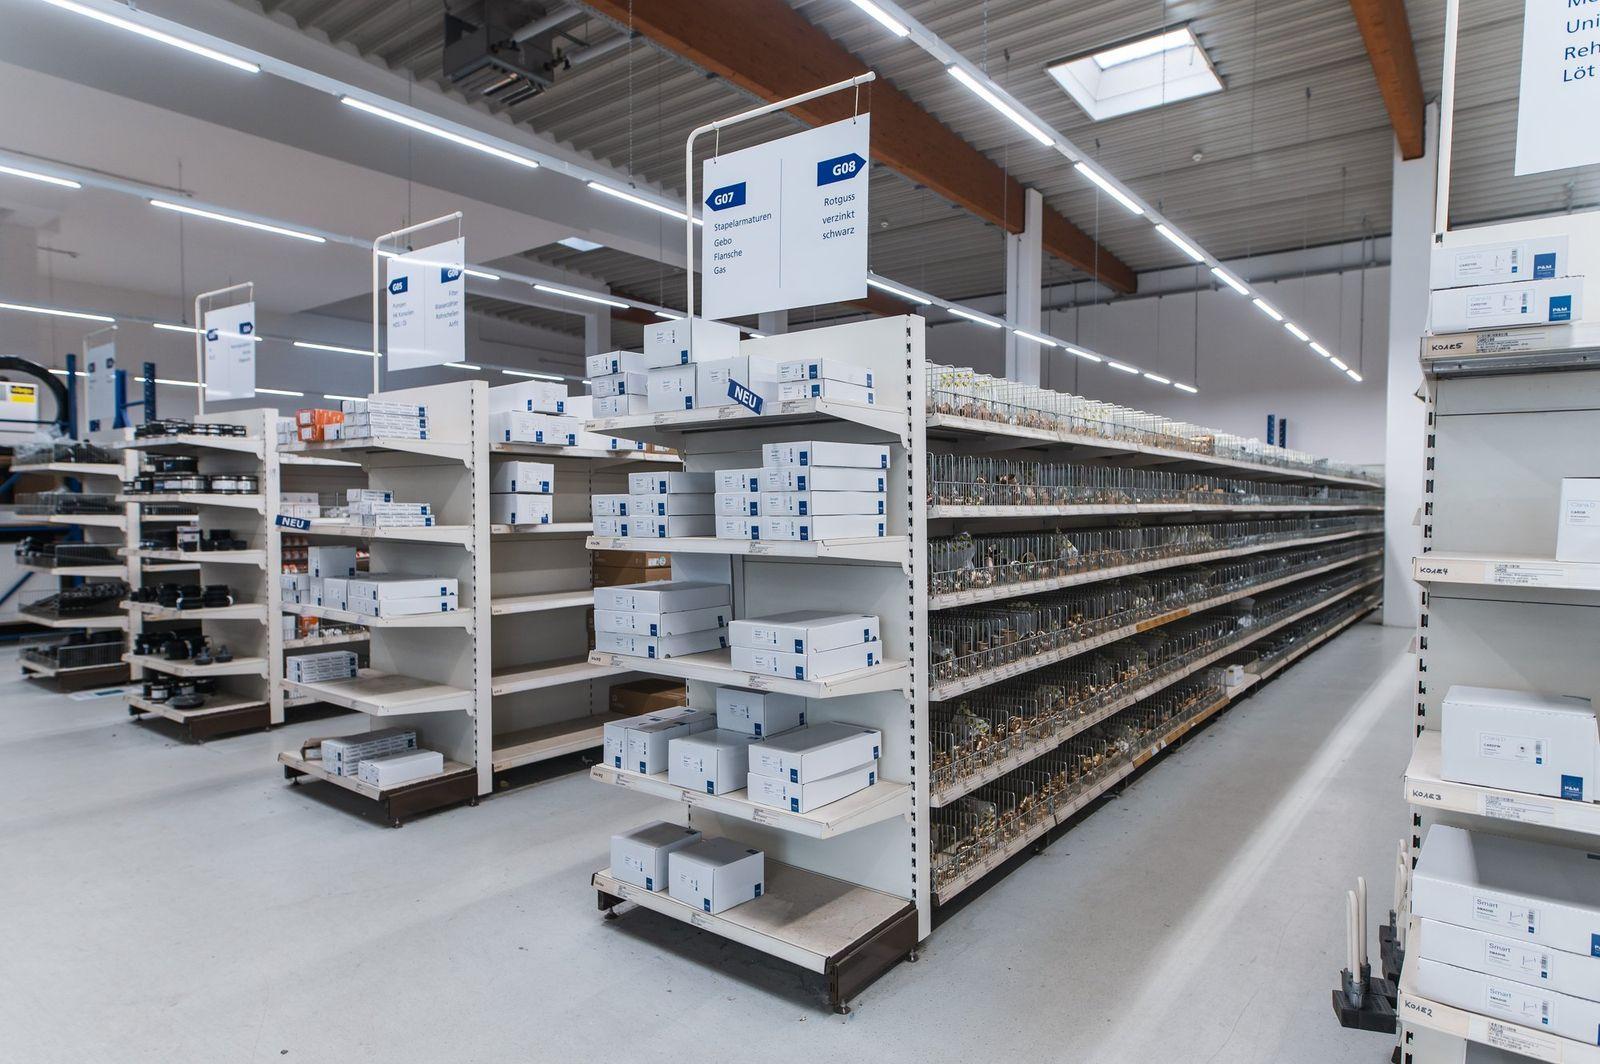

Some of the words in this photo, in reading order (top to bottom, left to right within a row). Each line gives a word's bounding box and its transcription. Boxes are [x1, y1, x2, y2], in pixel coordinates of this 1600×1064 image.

[1563, 64, 1596, 82] Löt
[832, 160, 856, 176] G08
[714, 191, 734, 206] G07
[824, 193, 855, 207] Rotguss
[714, 212, 772, 232] Stapelarmaturen
[822, 210, 855, 225] verzinkt
[822, 227, 855, 240] schwarz
[714, 237, 732, 247] Gebo
[714, 249, 742, 261] Flansche
[713, 266, 726, 275] Gas
[734, 385, 757, 408] NEU
[281, 516, 304, 529] NEU
[1476, 898, 1498, 909] Smart
[1488, 942, 1511, 953] Smart
